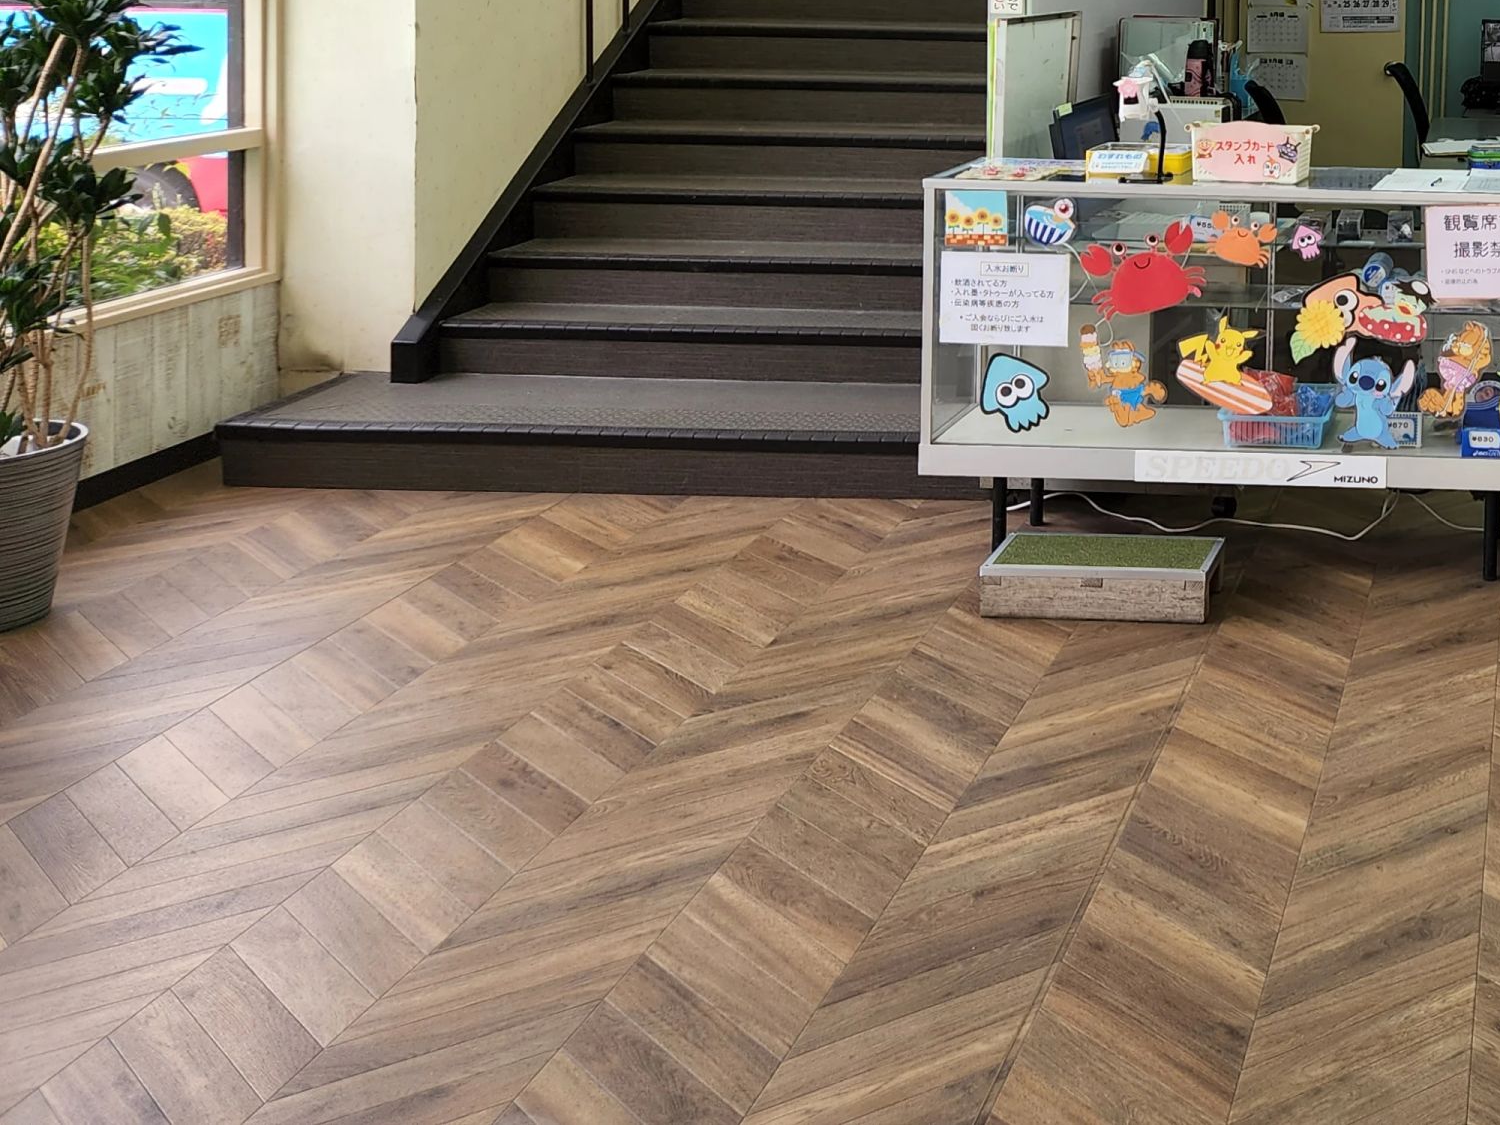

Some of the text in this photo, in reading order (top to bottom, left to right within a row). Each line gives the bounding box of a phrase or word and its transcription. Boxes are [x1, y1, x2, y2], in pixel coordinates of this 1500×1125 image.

[1214, 140, 1276, 152] スタンプカード
[1233, 153, 1257, 165] 入れ
[985, 264, 1025, 274] 入水お断り
[1145, 455, 1379, 485] SPEEDO MIZUNO
